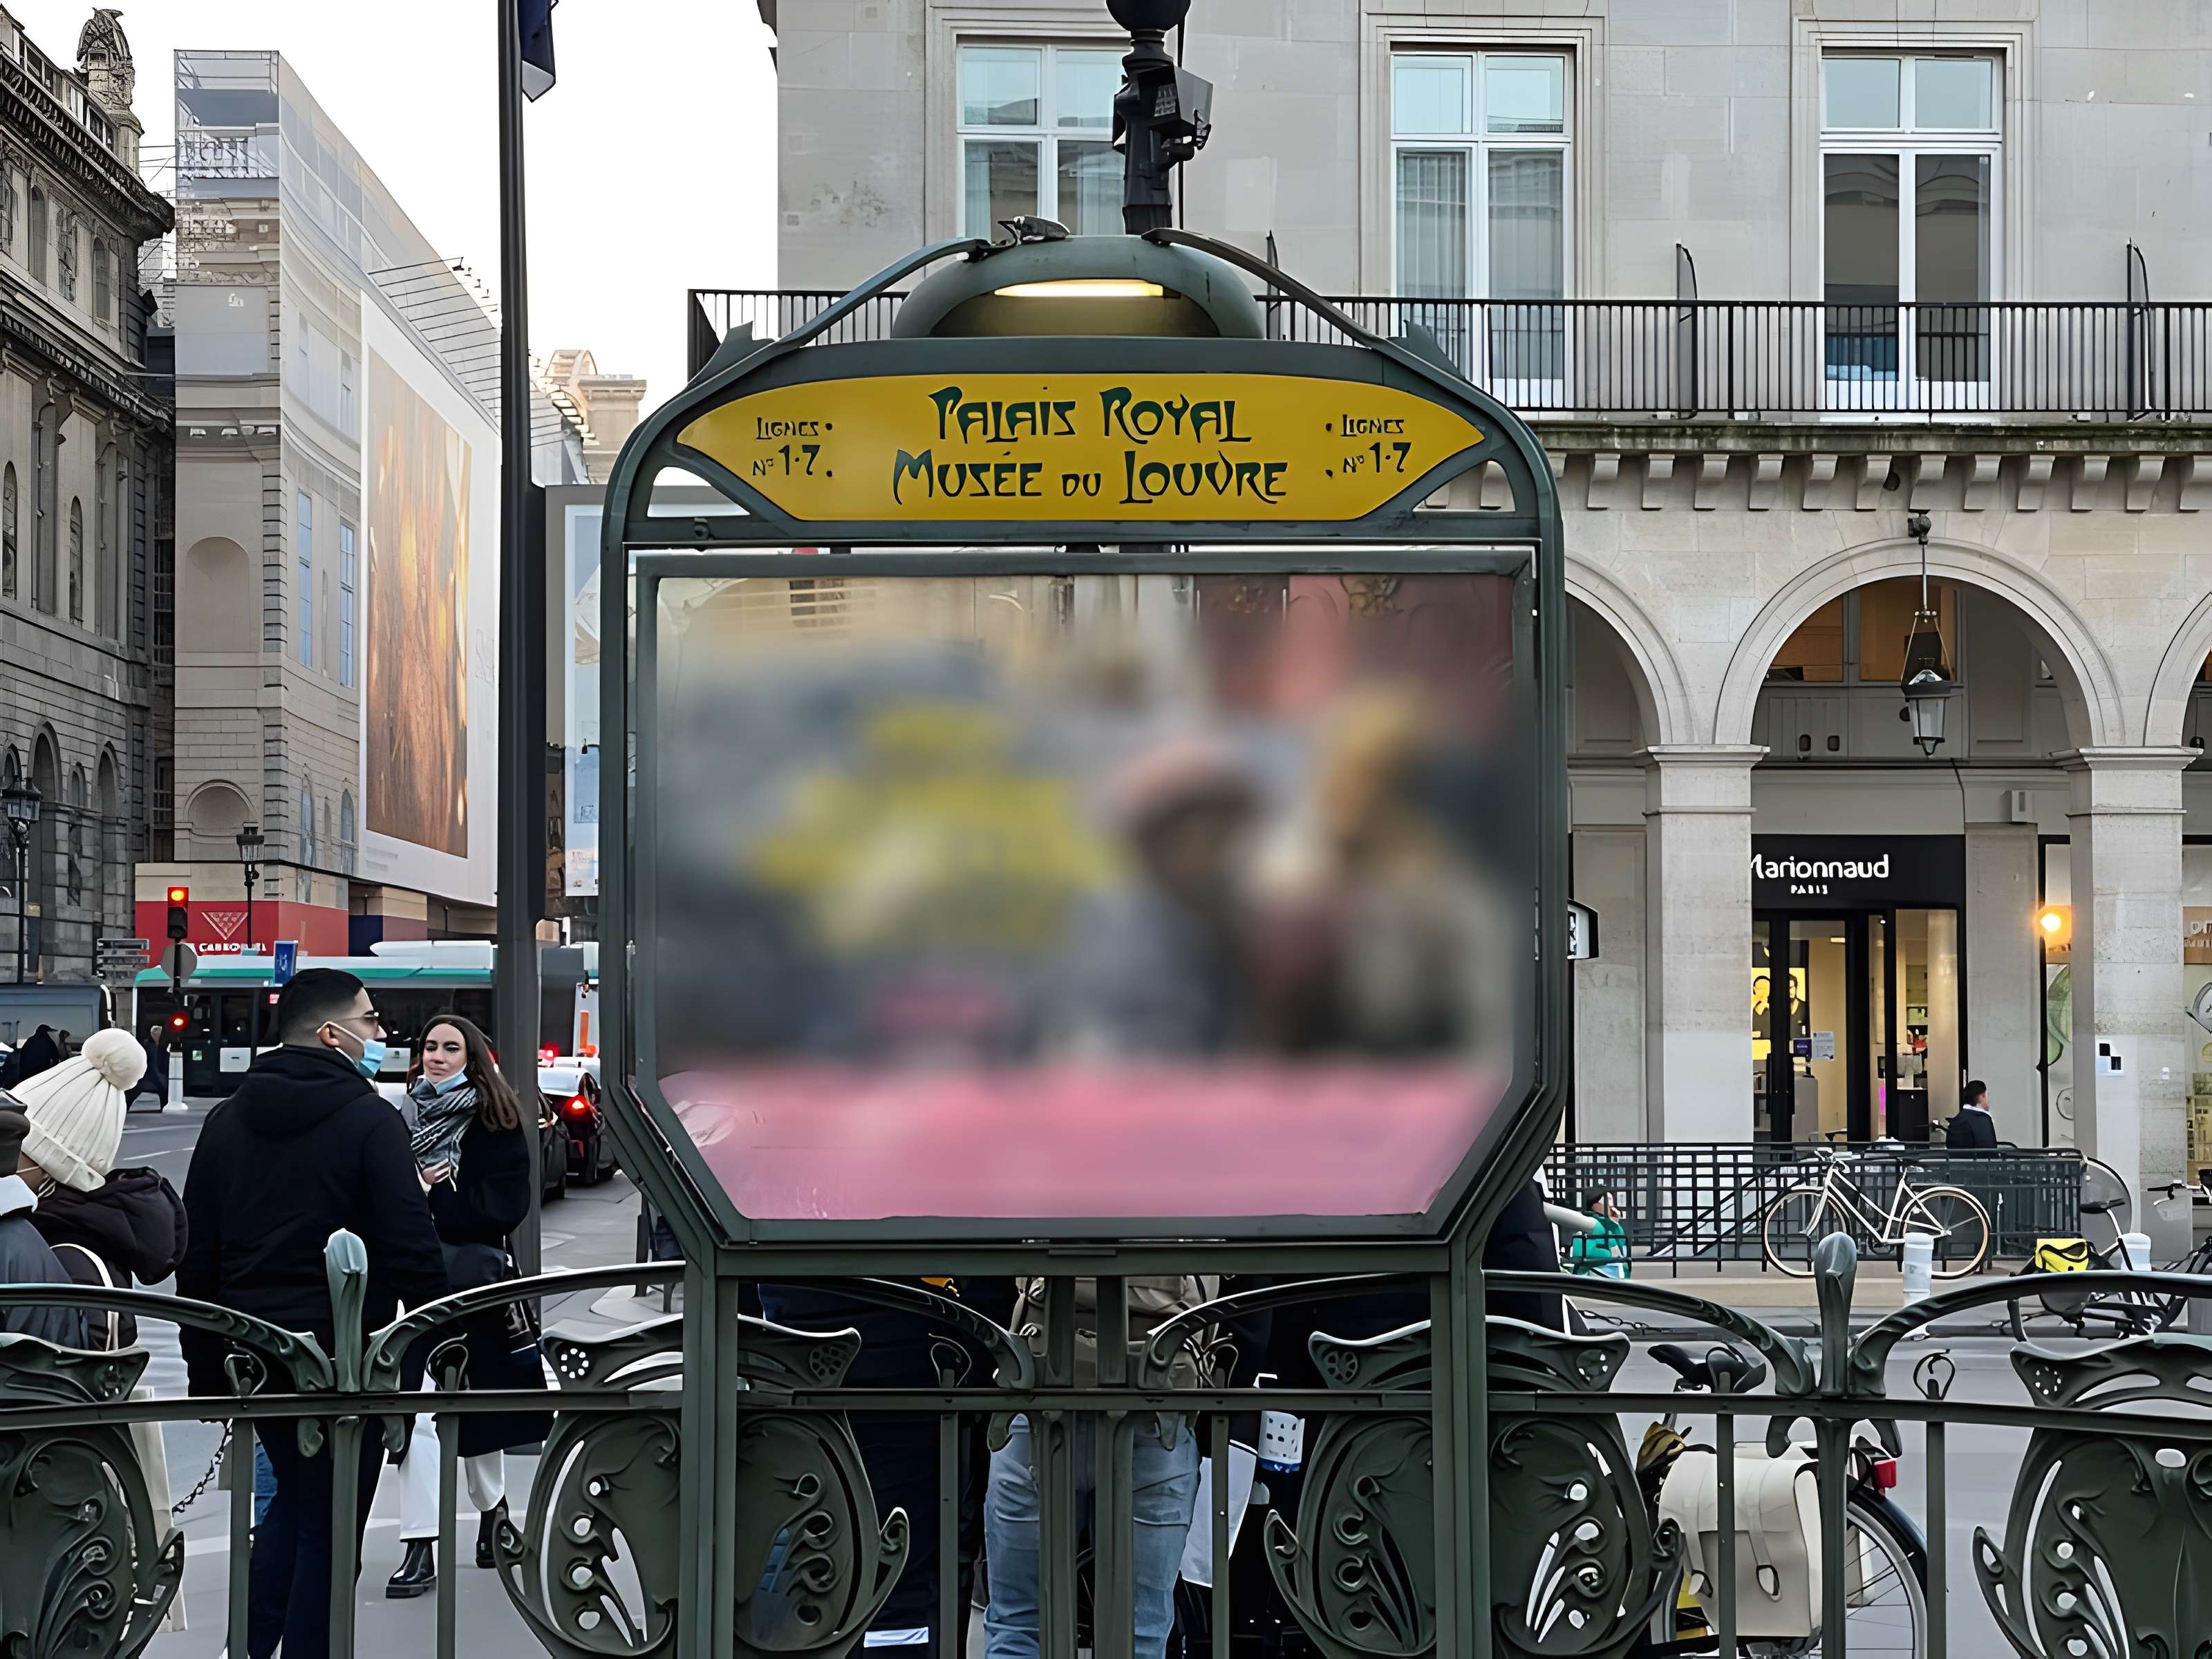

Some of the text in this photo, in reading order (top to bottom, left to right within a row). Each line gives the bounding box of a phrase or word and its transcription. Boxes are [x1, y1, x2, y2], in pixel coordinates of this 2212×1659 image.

[928, 386, 1253, 444] PALAIS ROYAL
[893, 449, 1288, 505] MUSÉE DU LOUVRE
